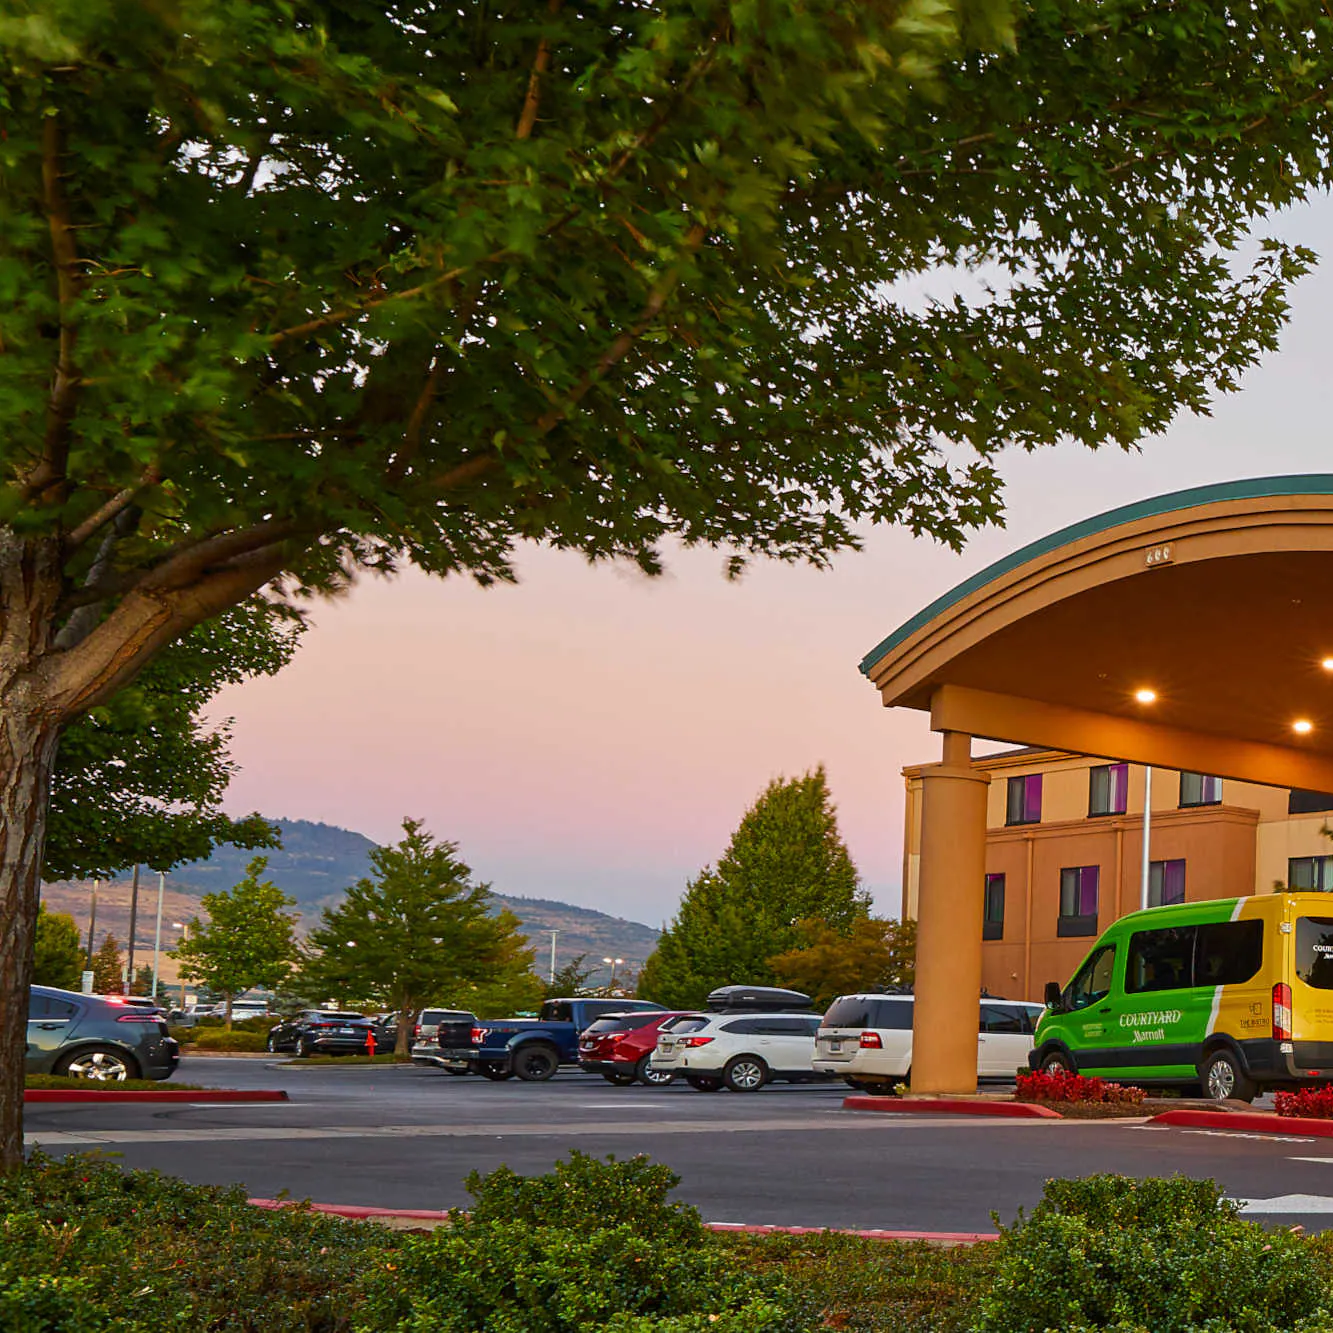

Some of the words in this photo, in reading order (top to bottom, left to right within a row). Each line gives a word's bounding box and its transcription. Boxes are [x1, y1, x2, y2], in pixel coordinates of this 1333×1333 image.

[1146, 546, 1170, 564] 600
[1119, 1009, 1182, 1027] COURTYARD
[1132, 1028, 1165, 1043] Marriott
